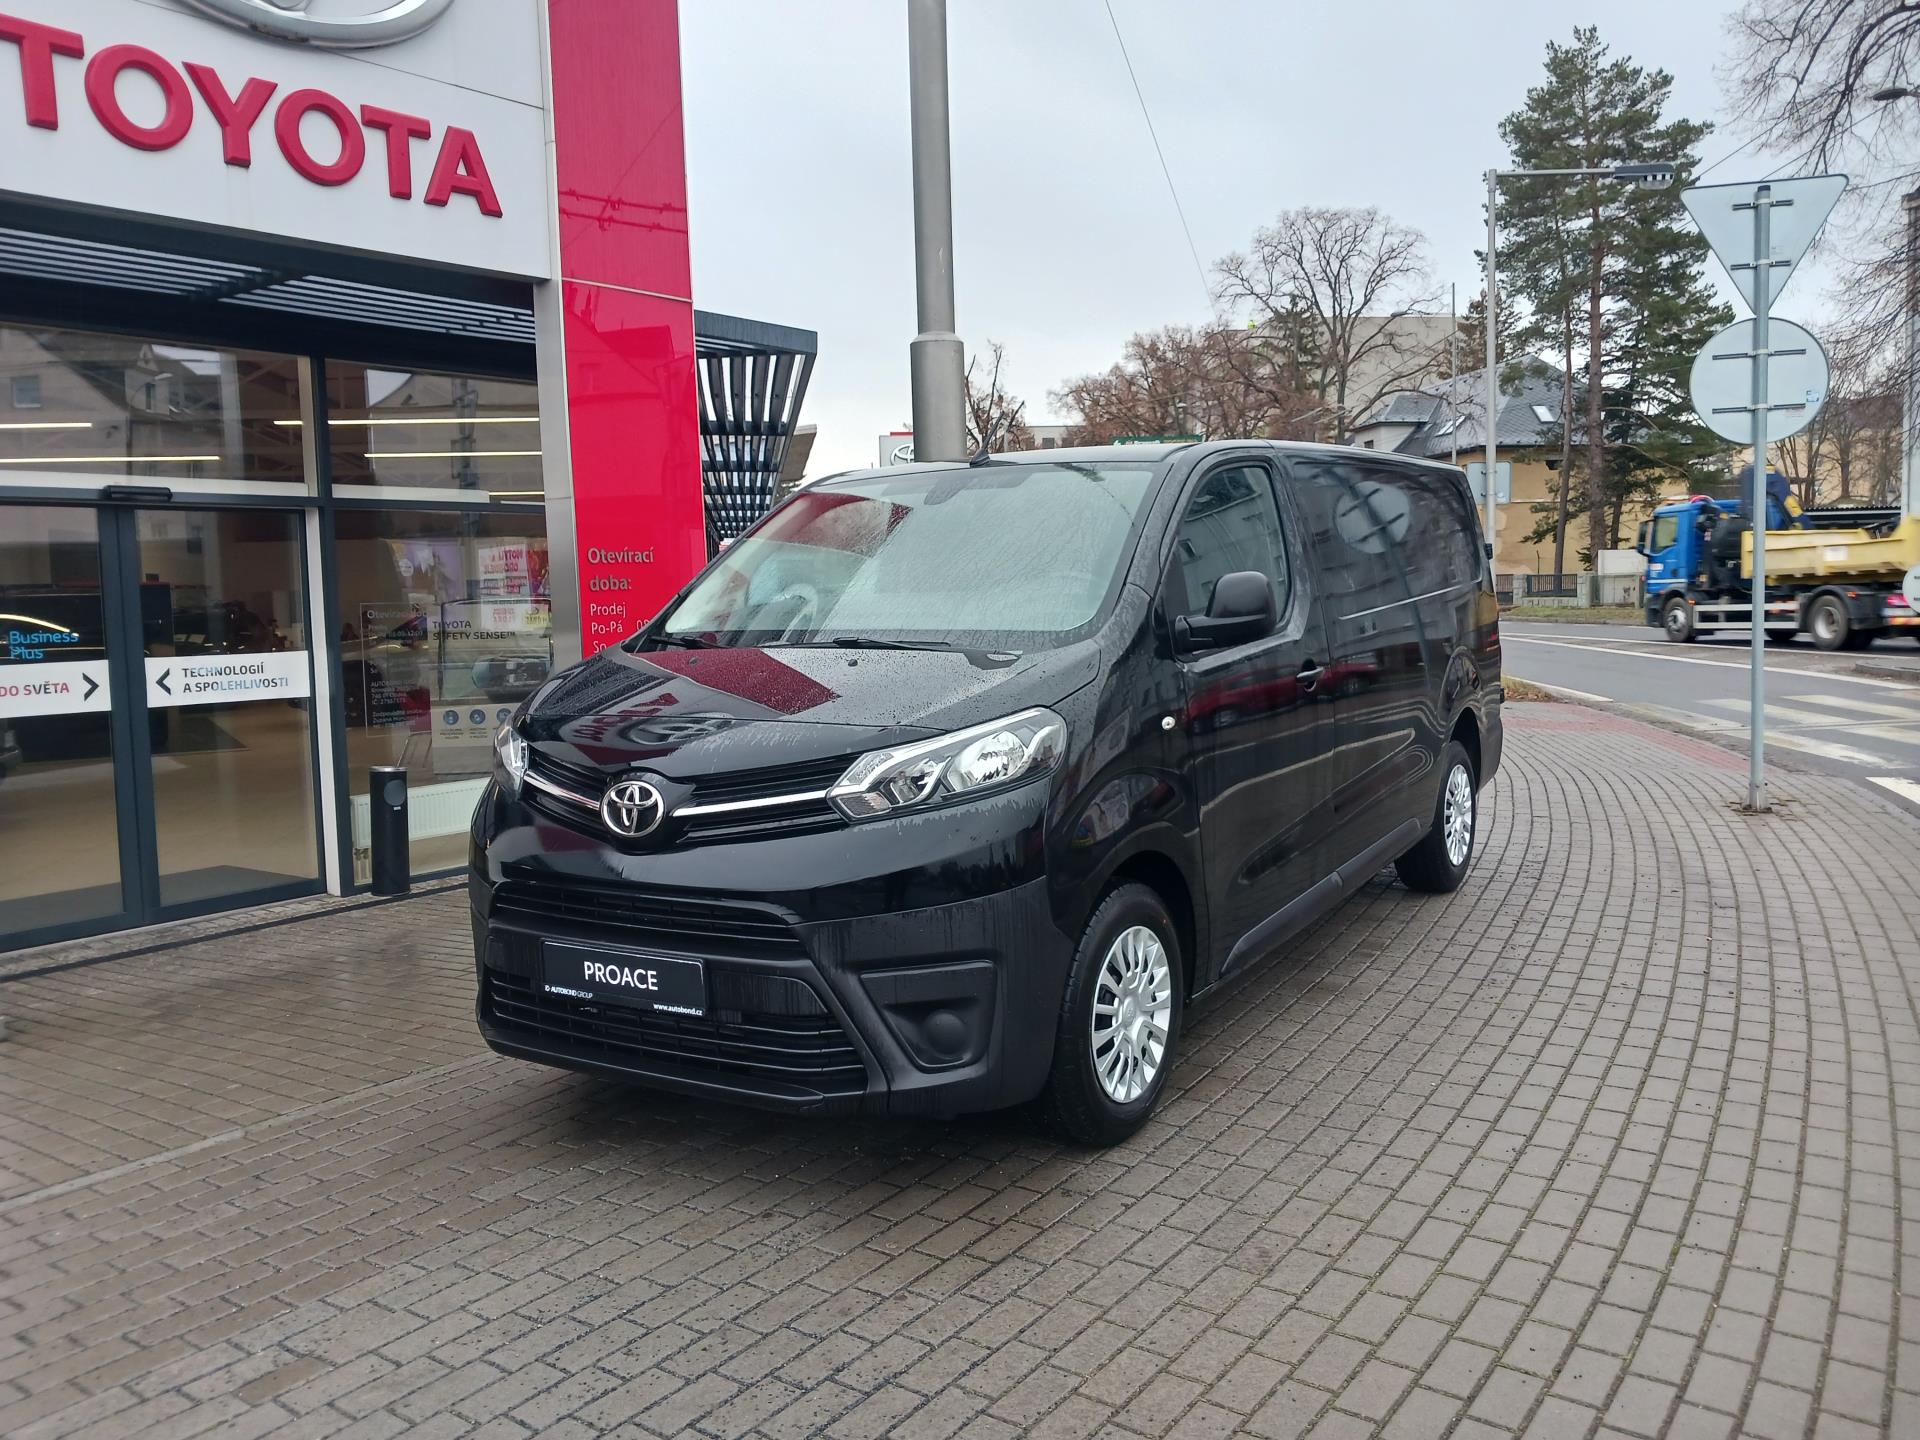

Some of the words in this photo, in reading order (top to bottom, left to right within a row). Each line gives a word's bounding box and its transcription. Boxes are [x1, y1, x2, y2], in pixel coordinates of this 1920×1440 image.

[0, 13, 503, 218] TOYOTA
[588, 546, 654, 564] Otevírací
[590, 575, 632, 591] doba:
[590, 602, 626, 618] Prodej
[591, 620, 623, 635] Po-Pá
[9, 630, 79, 645] Business
[9, 646, 44, 659] Plus
[182, 661, 264, 678] TECHNOLOGIÍ
[0, 685, 19, 697] DO
[23, 681, 70, 696] SVĚTA
[183, 683, 192, 693] A
[195, 677, 289, 692] SPOLEHLIVOSTI
[584, 961, 658, 990] PROACE
[653, 1003, 703, 1016] www.autobond.cz
